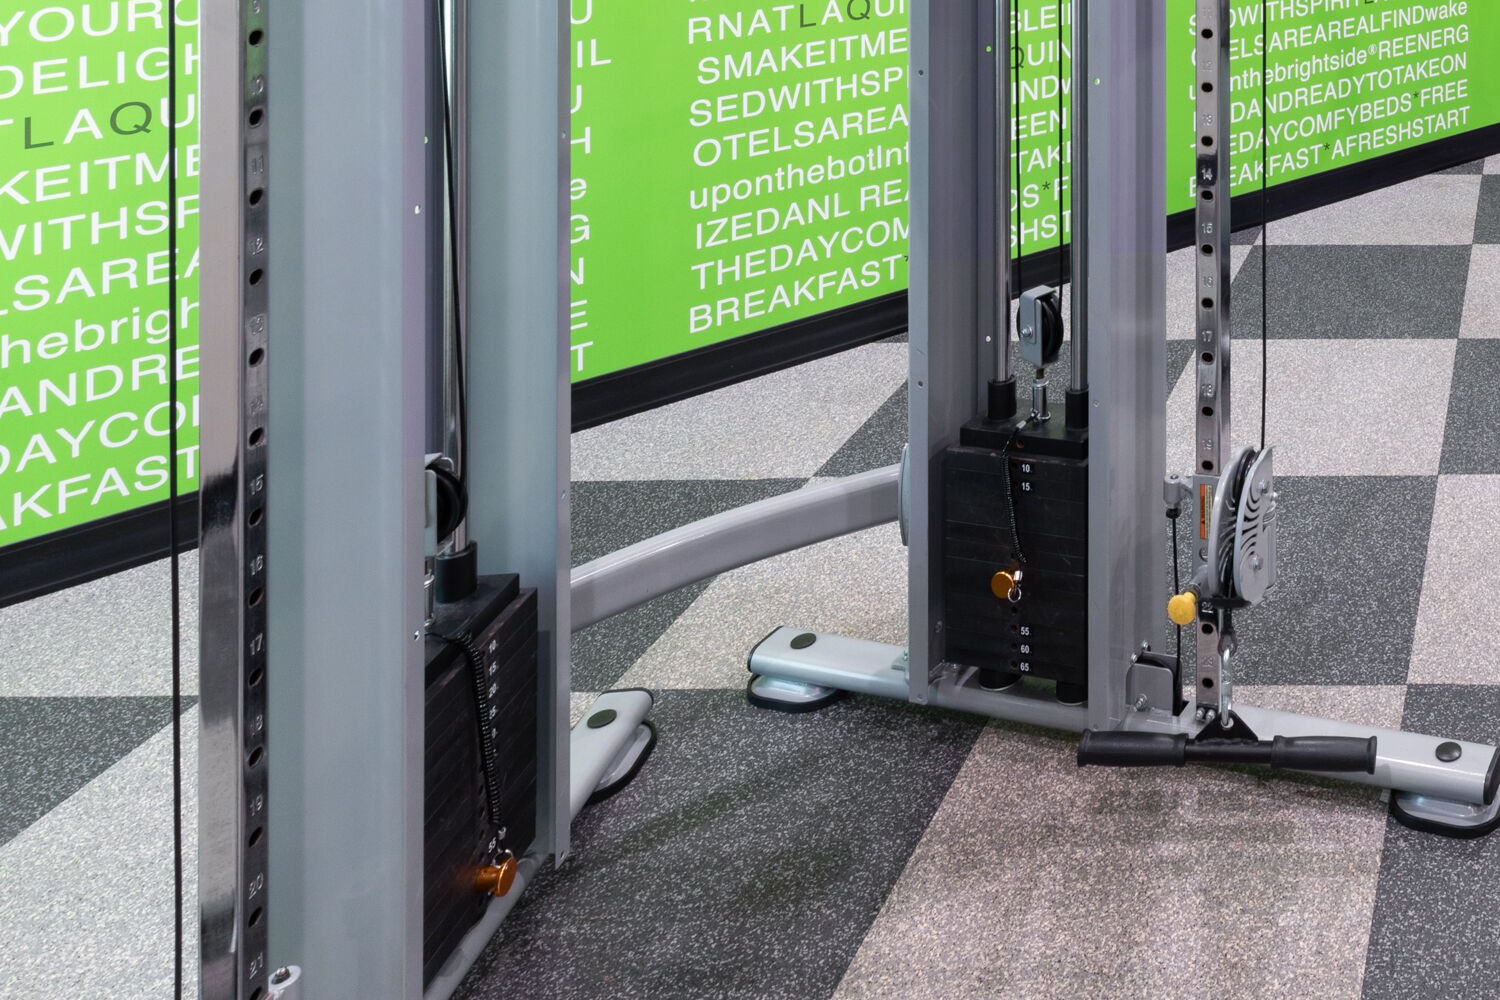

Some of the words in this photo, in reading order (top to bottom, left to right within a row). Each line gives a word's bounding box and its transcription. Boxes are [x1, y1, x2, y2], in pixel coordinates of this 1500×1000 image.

[1021, 464, 1031, 473] 10
[1021, 482, 1031, 491] 15
[1020, 626, 1030, 636] 55
[1020, 645, 1030, 654] 60
[1020, 662, 1030, 672] 65
